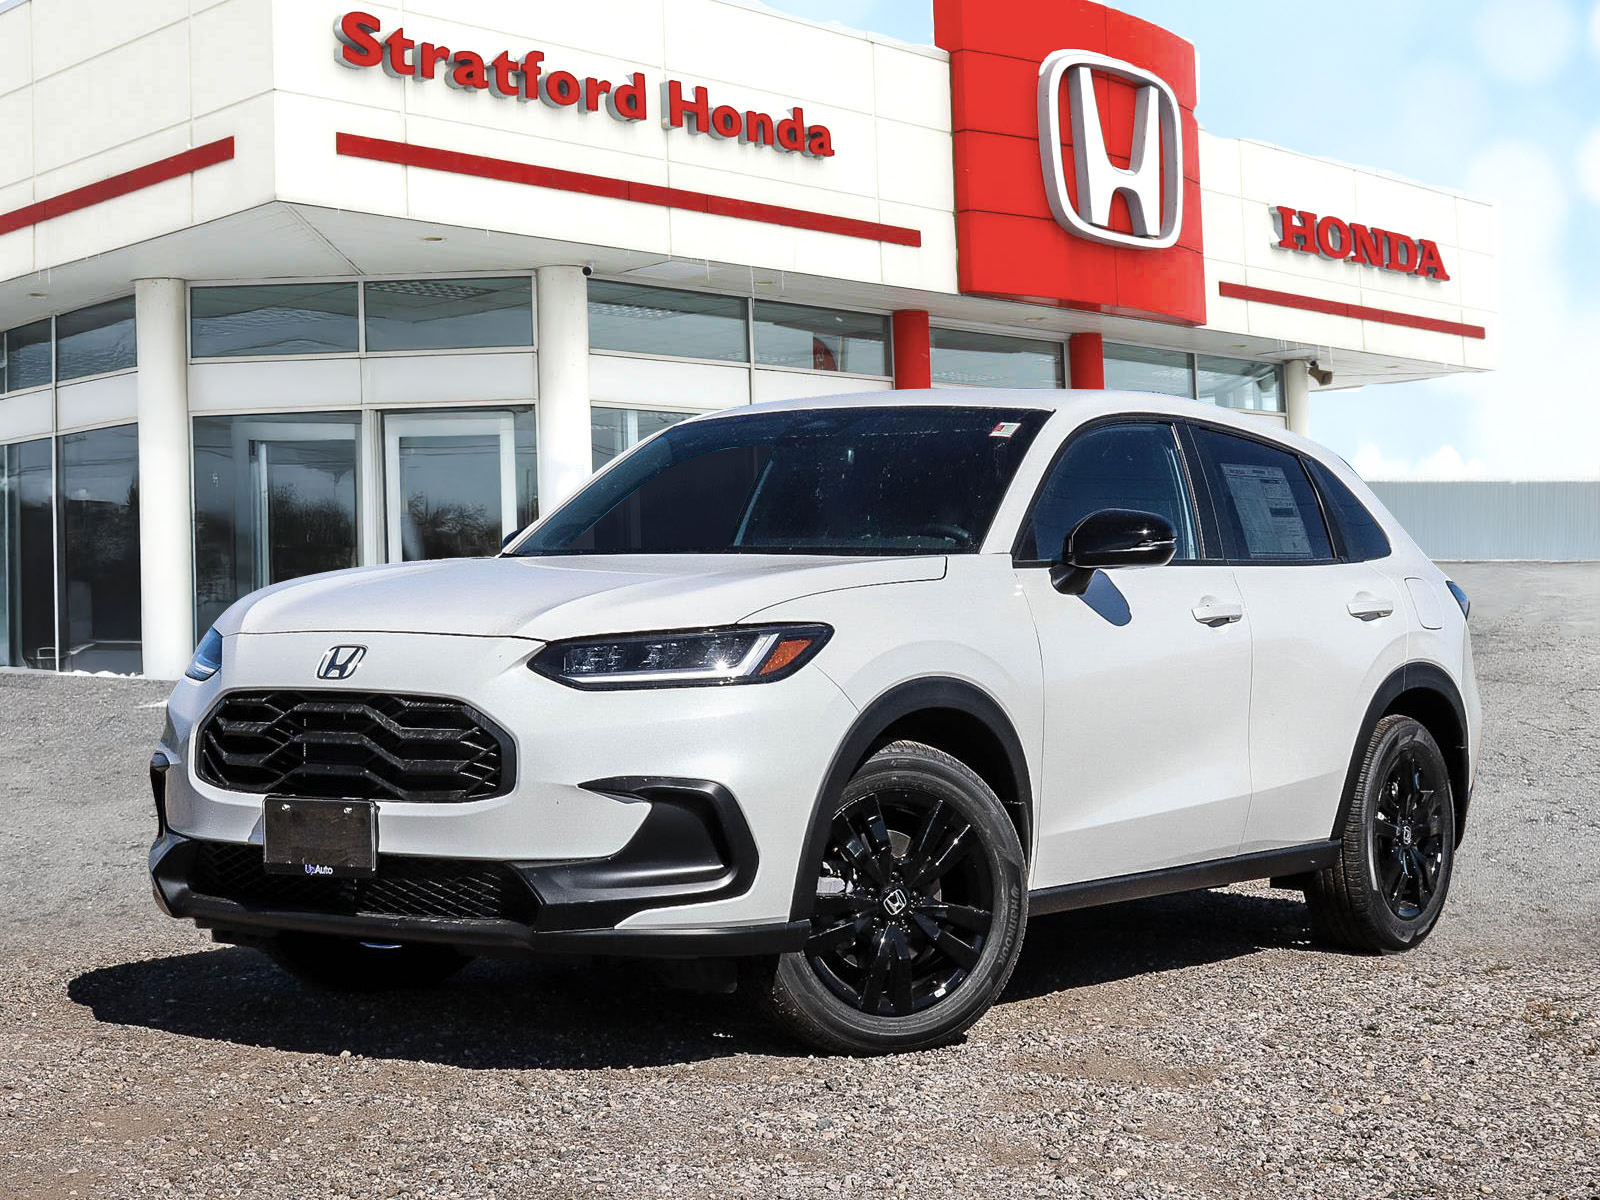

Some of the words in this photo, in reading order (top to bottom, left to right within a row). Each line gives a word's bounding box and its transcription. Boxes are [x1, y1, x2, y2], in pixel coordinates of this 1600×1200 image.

[335, 11, 646, 121] Stratford
[663, 80, 834, 158] Honda
[1270, 206, 1450, 281] HONDA
